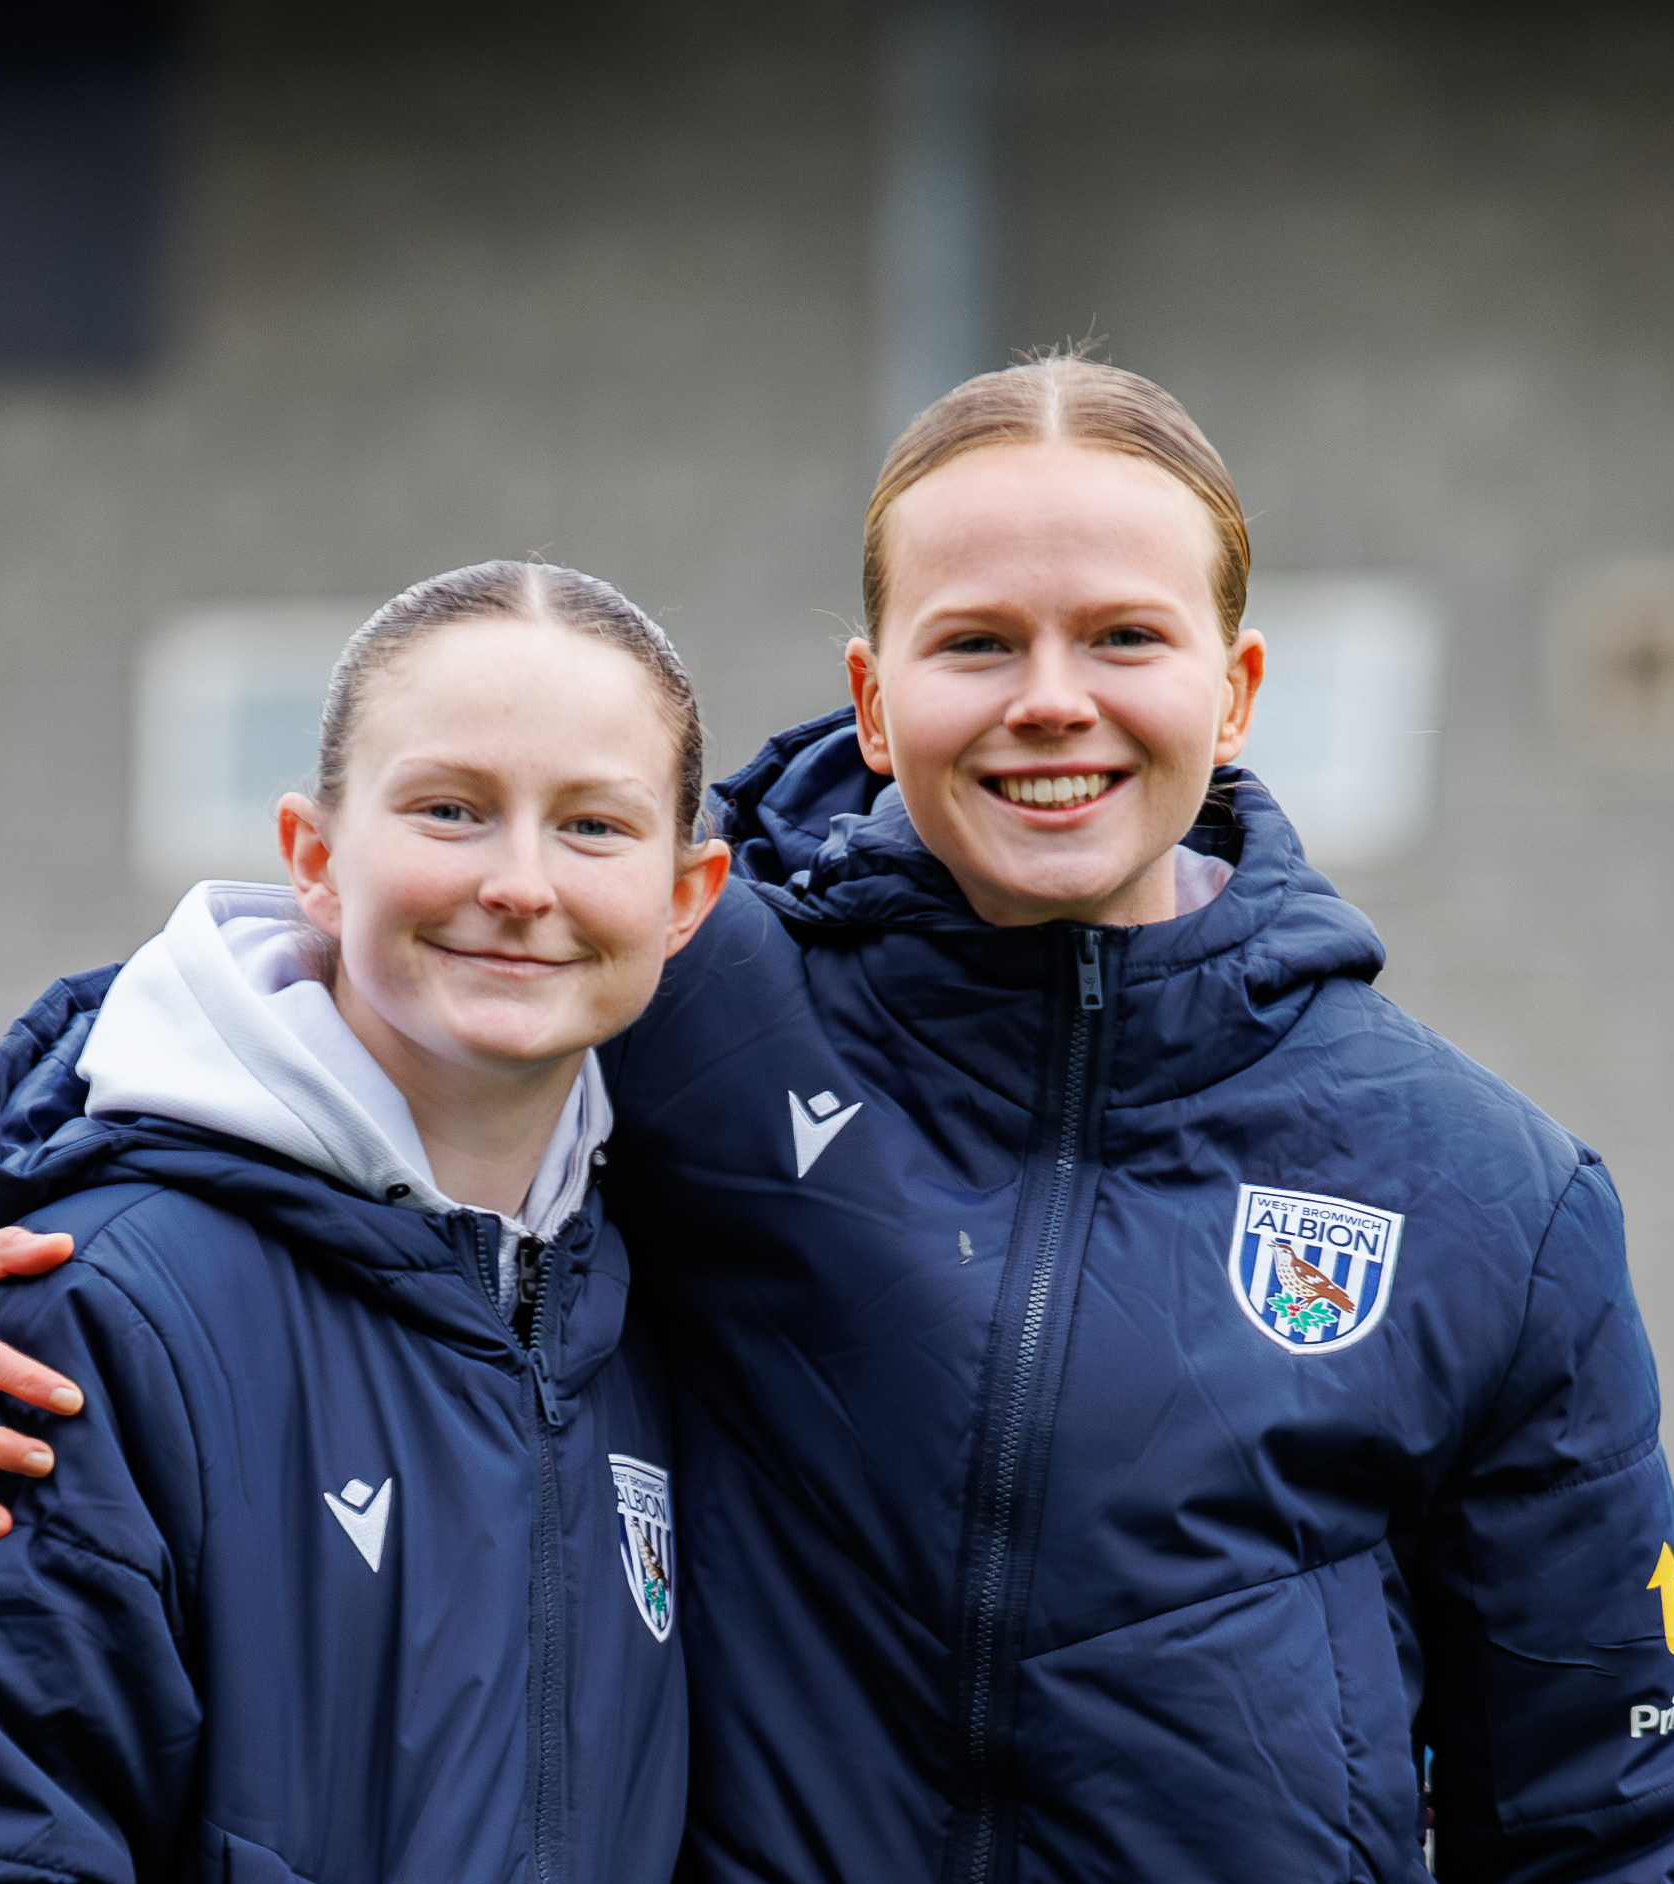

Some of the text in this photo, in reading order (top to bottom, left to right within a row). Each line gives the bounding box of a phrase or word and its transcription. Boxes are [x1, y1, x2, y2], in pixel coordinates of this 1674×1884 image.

[1253, 1210, 1379, 1255] ALBION
[1257, 1198, 1382, 1231] WEST BROMWICH
